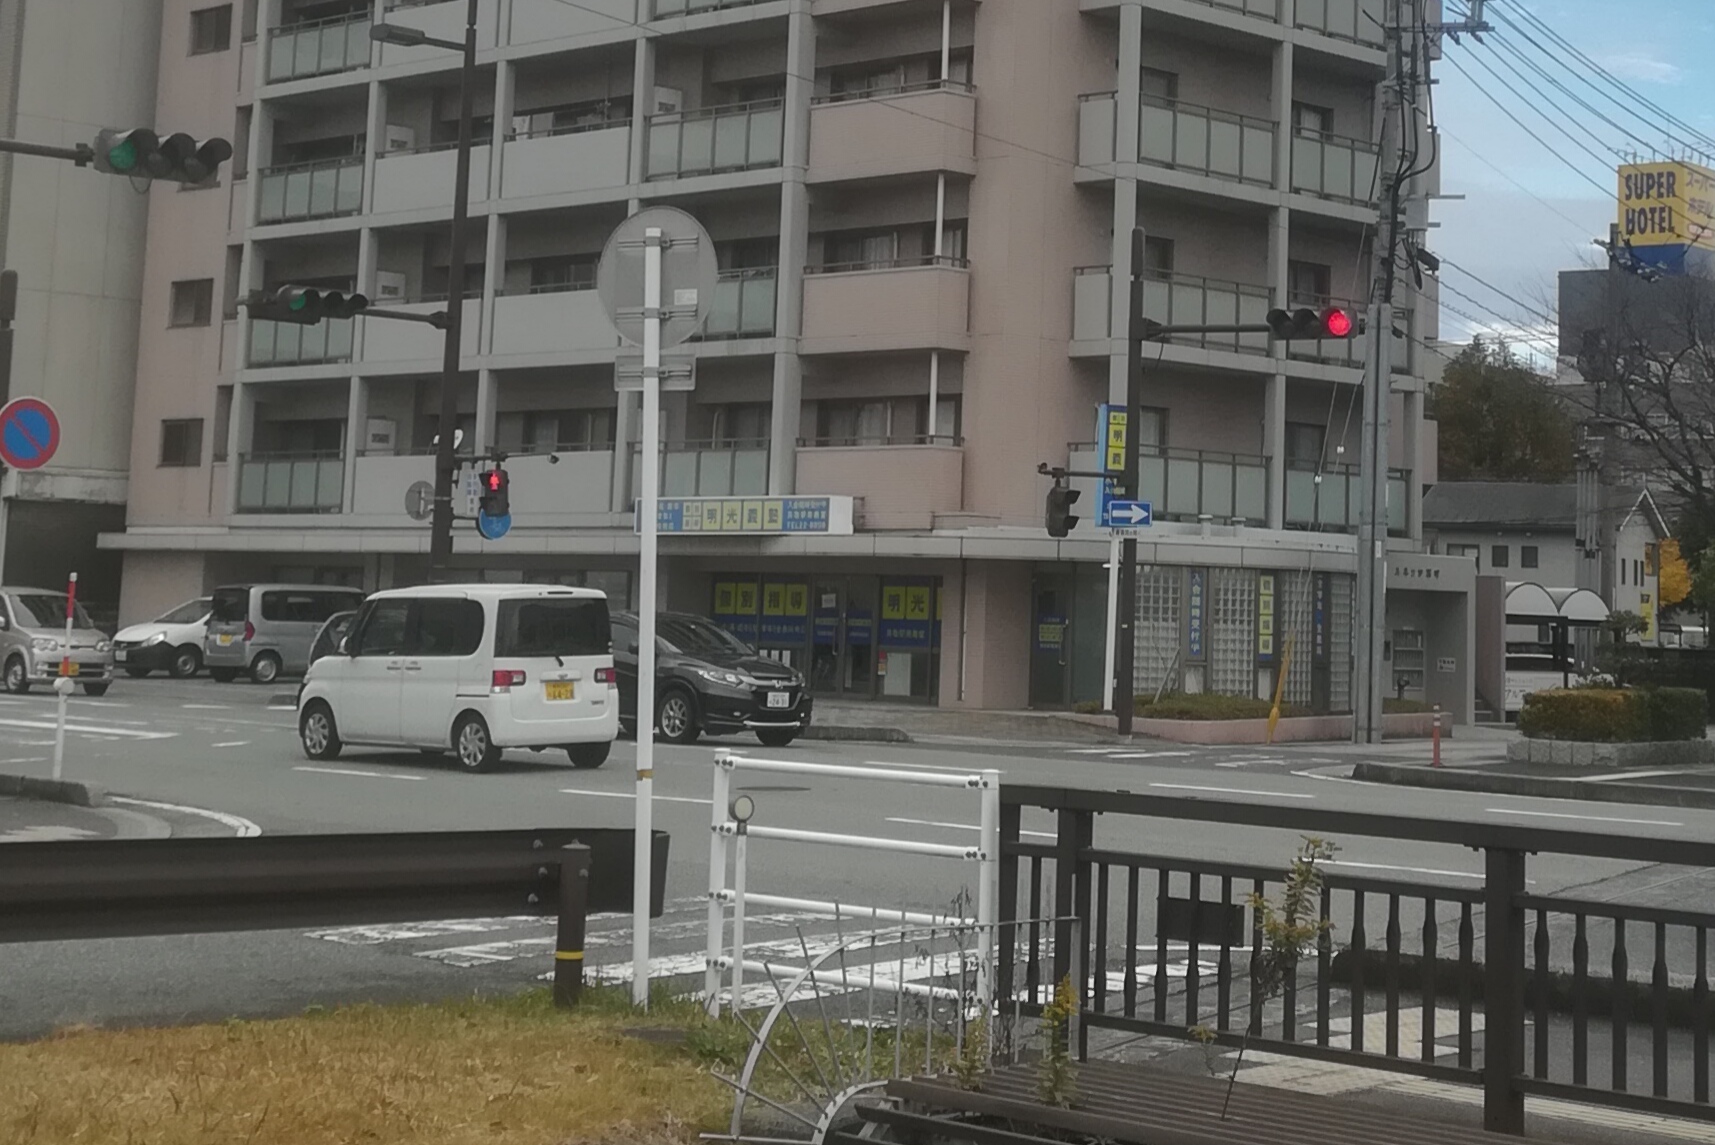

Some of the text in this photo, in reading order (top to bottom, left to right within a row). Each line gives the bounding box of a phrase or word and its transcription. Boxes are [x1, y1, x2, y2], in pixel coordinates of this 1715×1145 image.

[1625, 171, 1676, 201] SUPER
[1625, 206, 1675, 235] HOTEL
[888, 593, 925, 613] 明光
